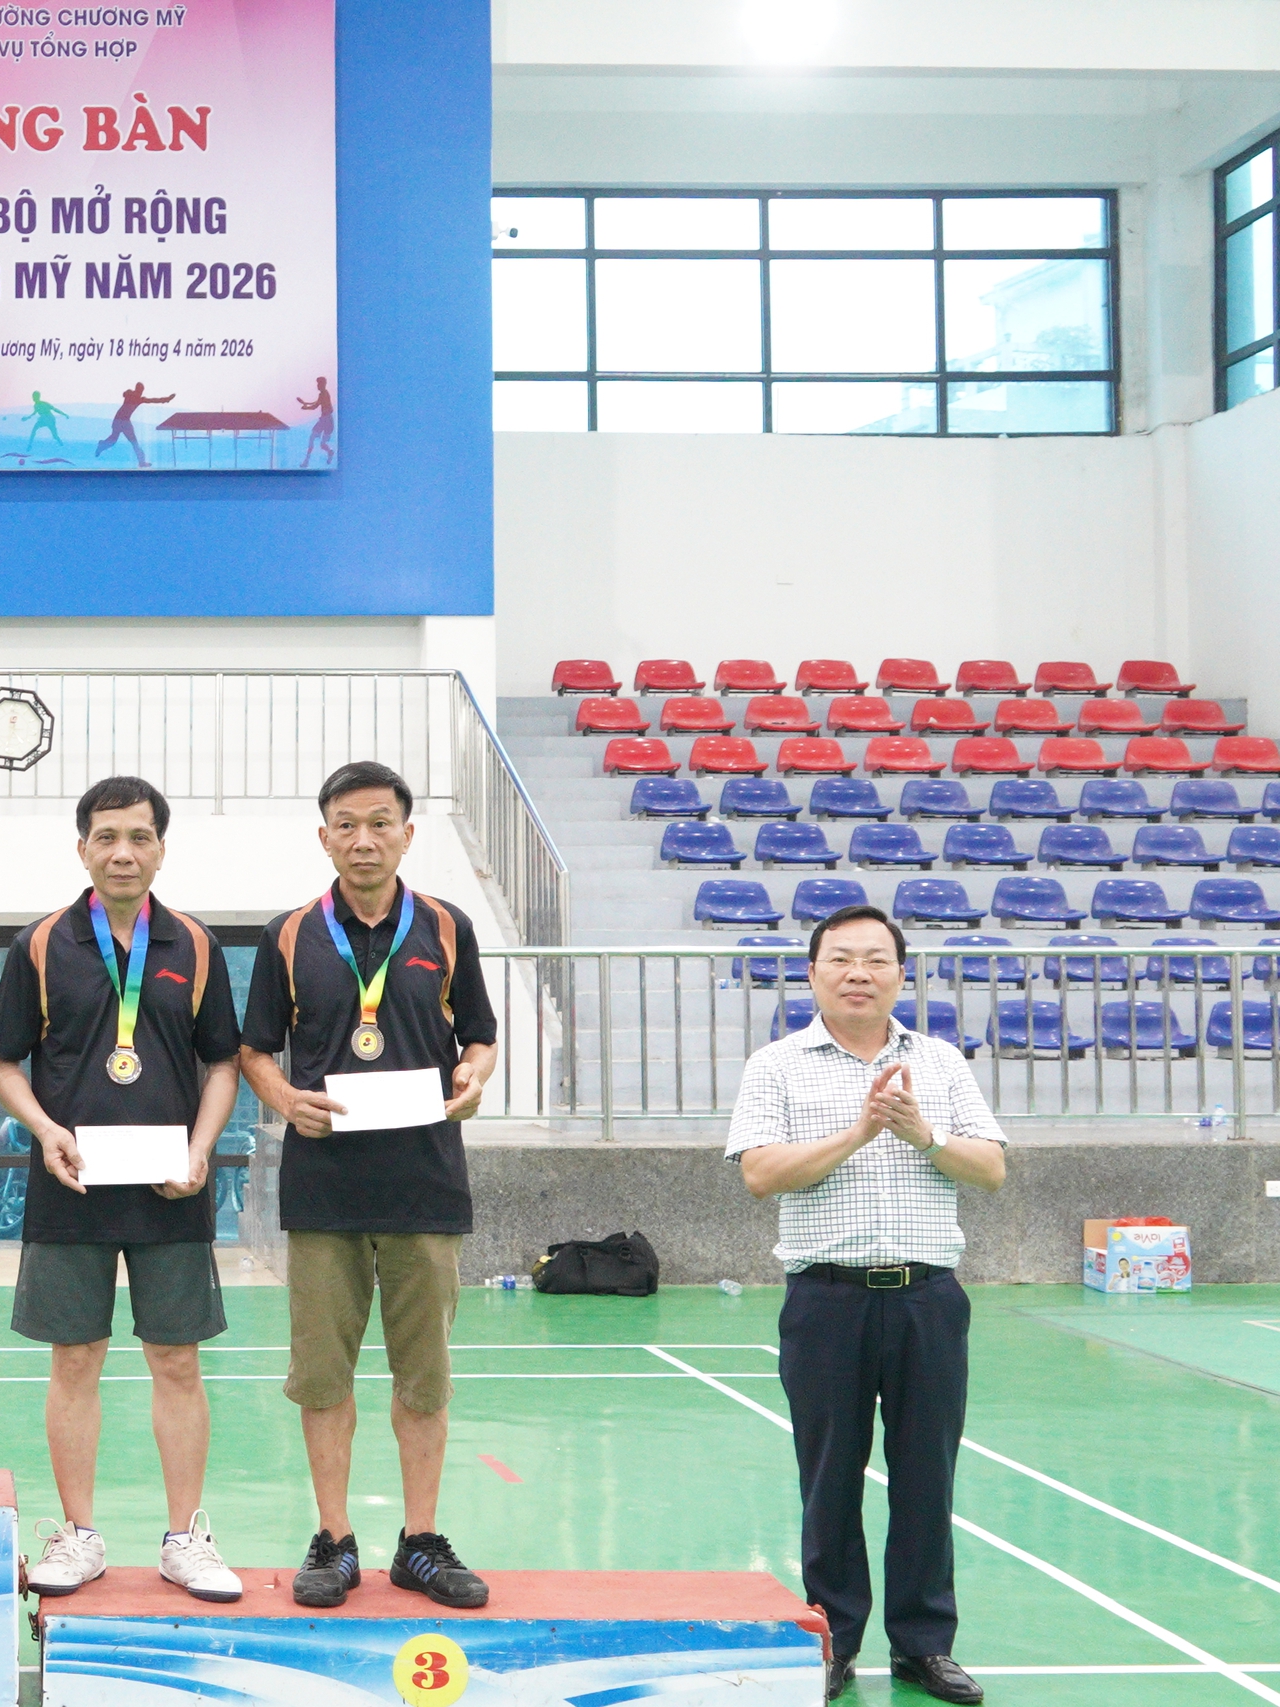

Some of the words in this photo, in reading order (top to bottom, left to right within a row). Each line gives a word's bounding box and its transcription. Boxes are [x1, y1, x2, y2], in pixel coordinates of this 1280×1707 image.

[58, 8, 149, 26] CHƯƠNG
[156, 5, 186, 26] MỸ
[30, 31, 87, 58] TỔNG
[95, 40, 138, 62] HỢP
[82, 92, 212, 152] BÀN
[52, 184, 112, 234] MỞ
[124, 189, 227, 243] RỘNG
[15, 254, 72, 299] MỸ
[85, 254, 172, 299] NĂM
[186, 262, 276, 300] 2026
[40, 338, 64, 361] Mỹ,
[68, 337, 104, 361] ngày
[109, 338, 124, 357] 18
[129, 337, 169, 362] tháng
[172, 339, 182, 357] 4
[185, 338, 217, 357] năm
[220, 339, 254, 357] 2026
[411, 1651, 450, 1690] 3
